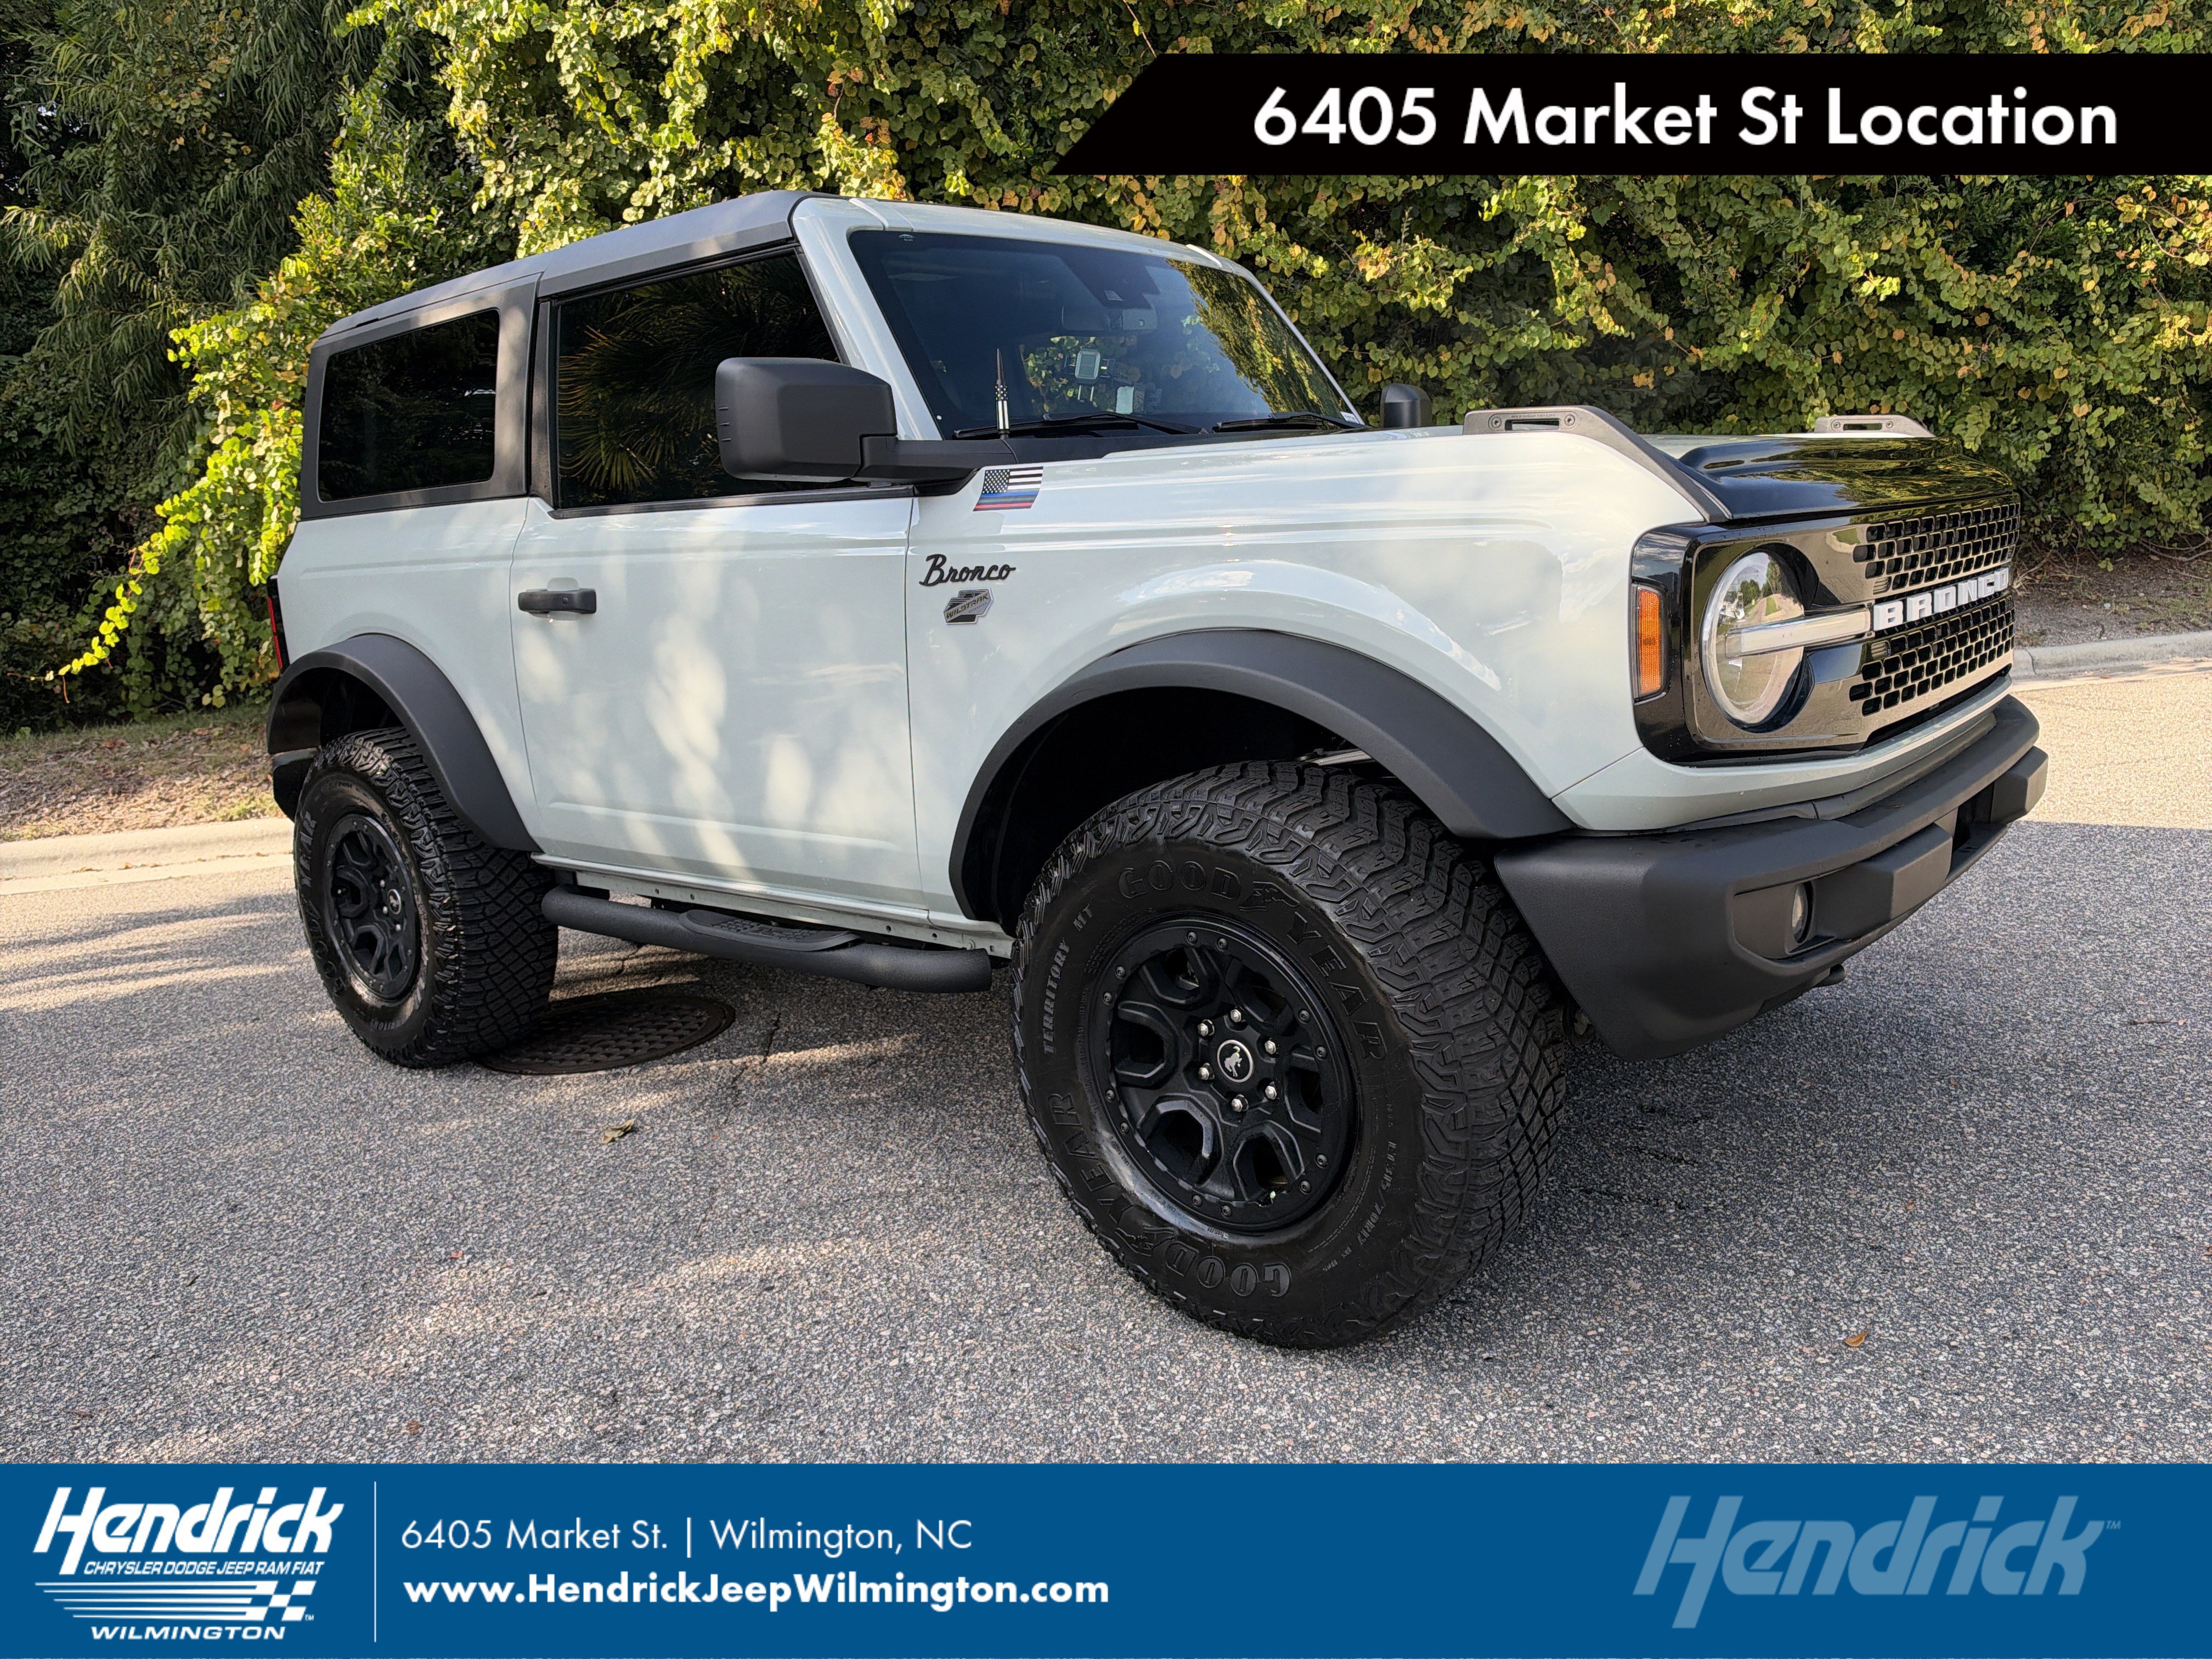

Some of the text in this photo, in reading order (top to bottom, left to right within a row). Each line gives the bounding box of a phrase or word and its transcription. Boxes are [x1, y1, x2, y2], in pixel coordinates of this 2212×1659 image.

[919, 554, 1016, 586] Bronco
[1874, 567, 2009, 631] BRONCO
[1043, 904, 1093, 1054] TERRITORY MT
[1118, 860, 1387, 1060] GOOD YEAR
[1048, 1093, 1135, 1225] YEAR
[1165, 1241, 1291, 1297] GOOD
